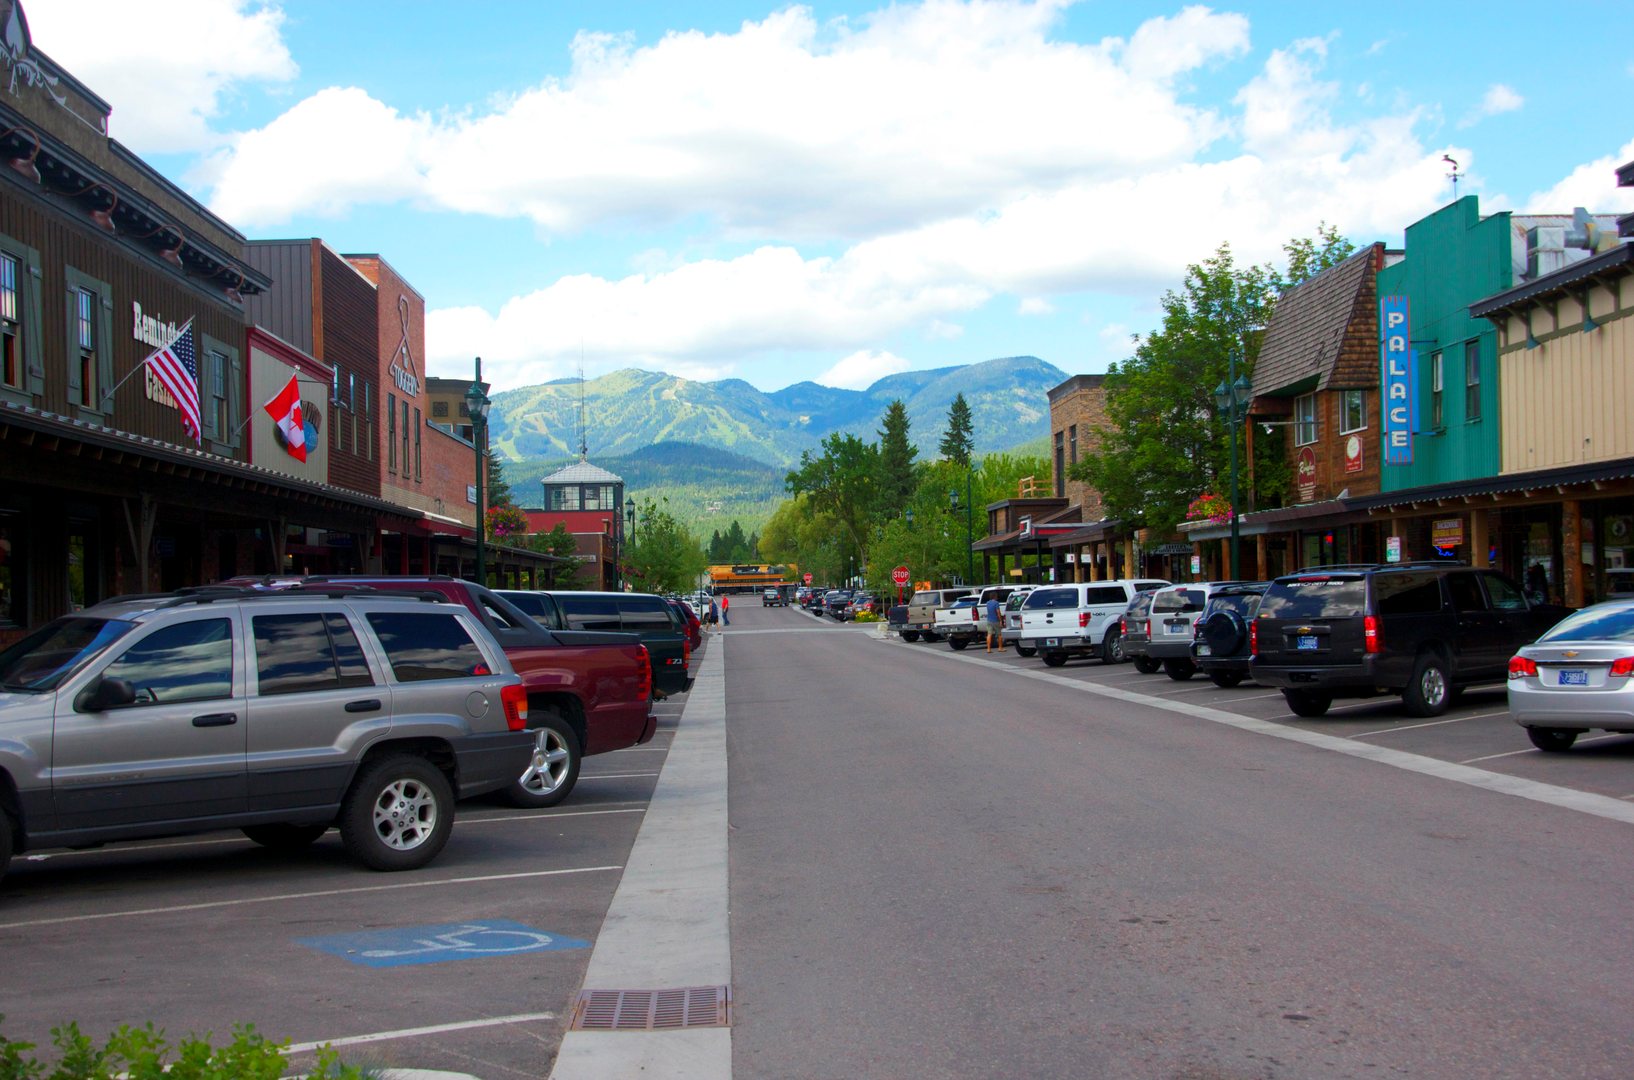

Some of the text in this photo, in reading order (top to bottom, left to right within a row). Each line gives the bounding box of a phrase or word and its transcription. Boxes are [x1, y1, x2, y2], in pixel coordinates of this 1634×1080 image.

[133, 300, 179, 350] Remingt
[393, 364, 418, 398] TOGGERY
[1387, 312, 1408, 447] PALACE
[893, 571, 909, 579] STOP
